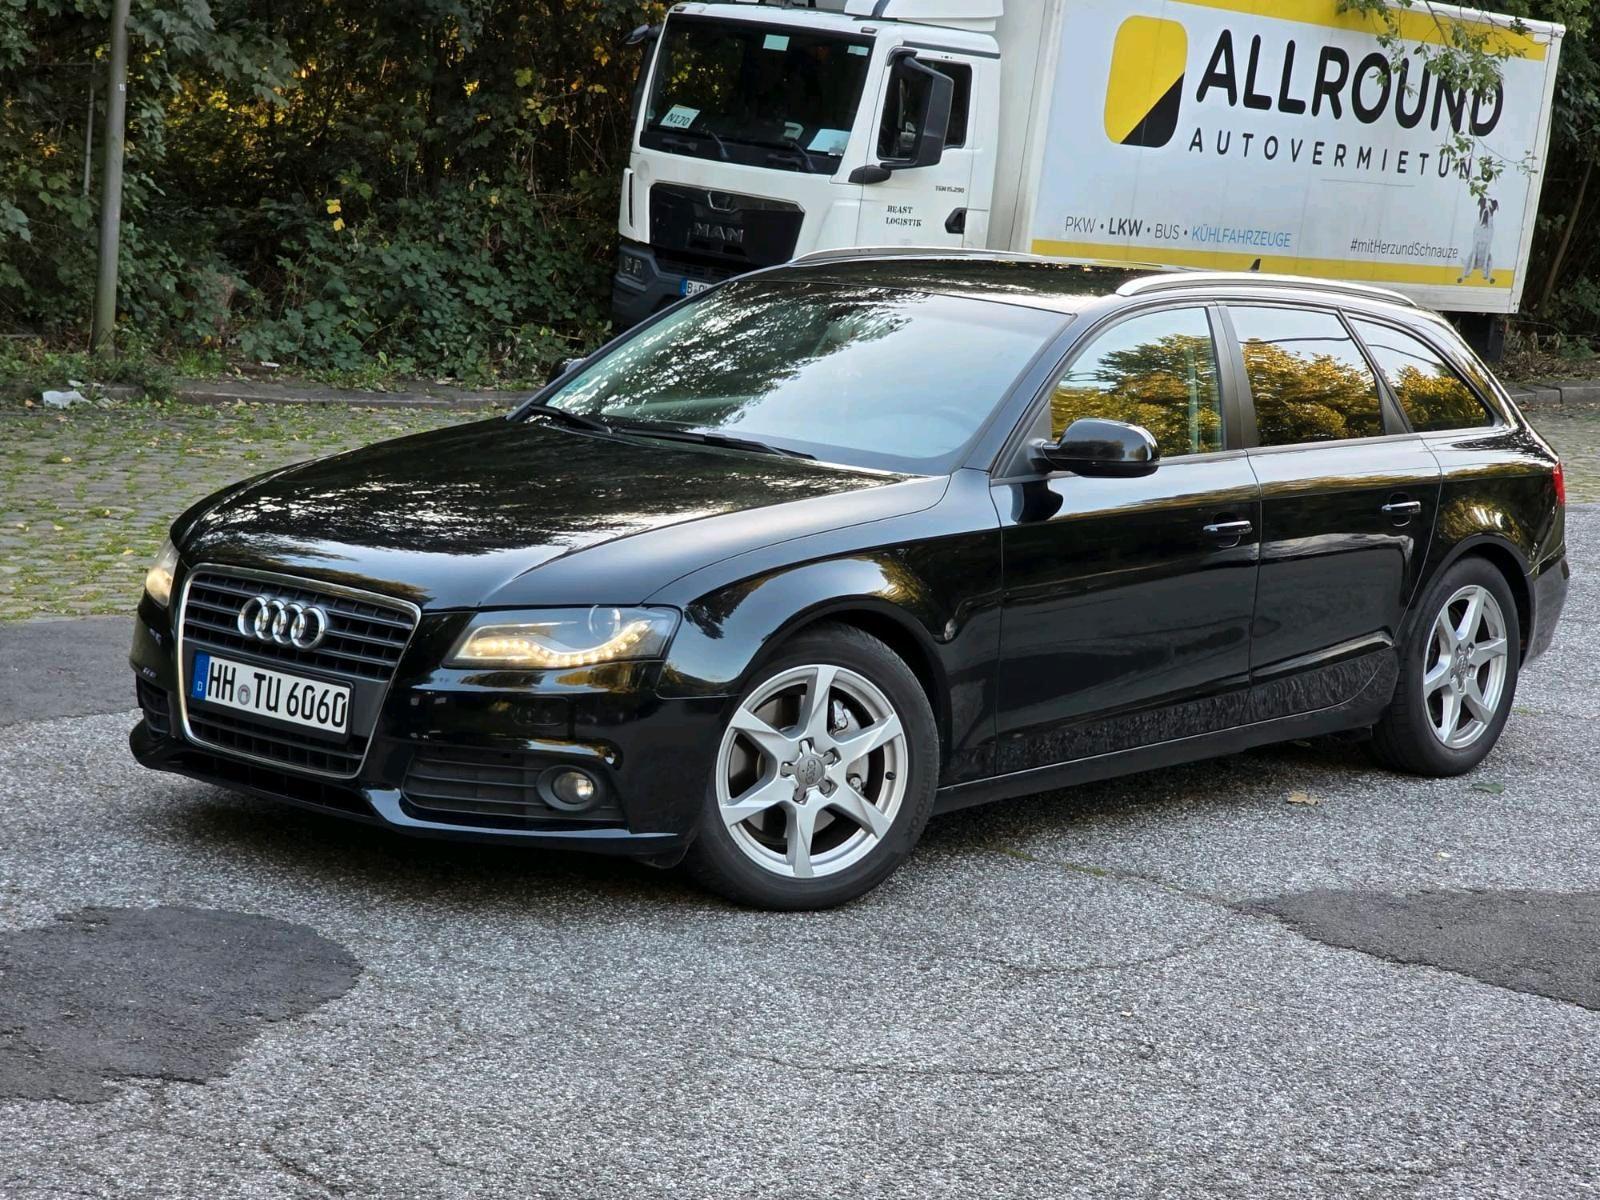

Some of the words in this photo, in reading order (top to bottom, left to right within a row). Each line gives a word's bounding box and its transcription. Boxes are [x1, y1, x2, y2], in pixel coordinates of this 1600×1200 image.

[1196, 29, 1504, 137] ALLROUND
[667, 113, 691, 127] N170
[887, 205, 913, 214] BEAST
[694, 222, 744, 243] MAN
[885, 217, 922, 228] LOGISTIK
[1065, 216, 1096, 233] PKW
[1108, 218, 1143, 237] LKW
[1155, 223, 1180, 240] BUS
[1191, 223, 1292, 248] KÜHLFAHRZEUGE
[1350, 238, 1459, 259] #mitHerzundSchnauze
[207, 662, 237, 702] HH
[254, 672, 282, 713] TU
[286, 682, 347, 728] 6060
